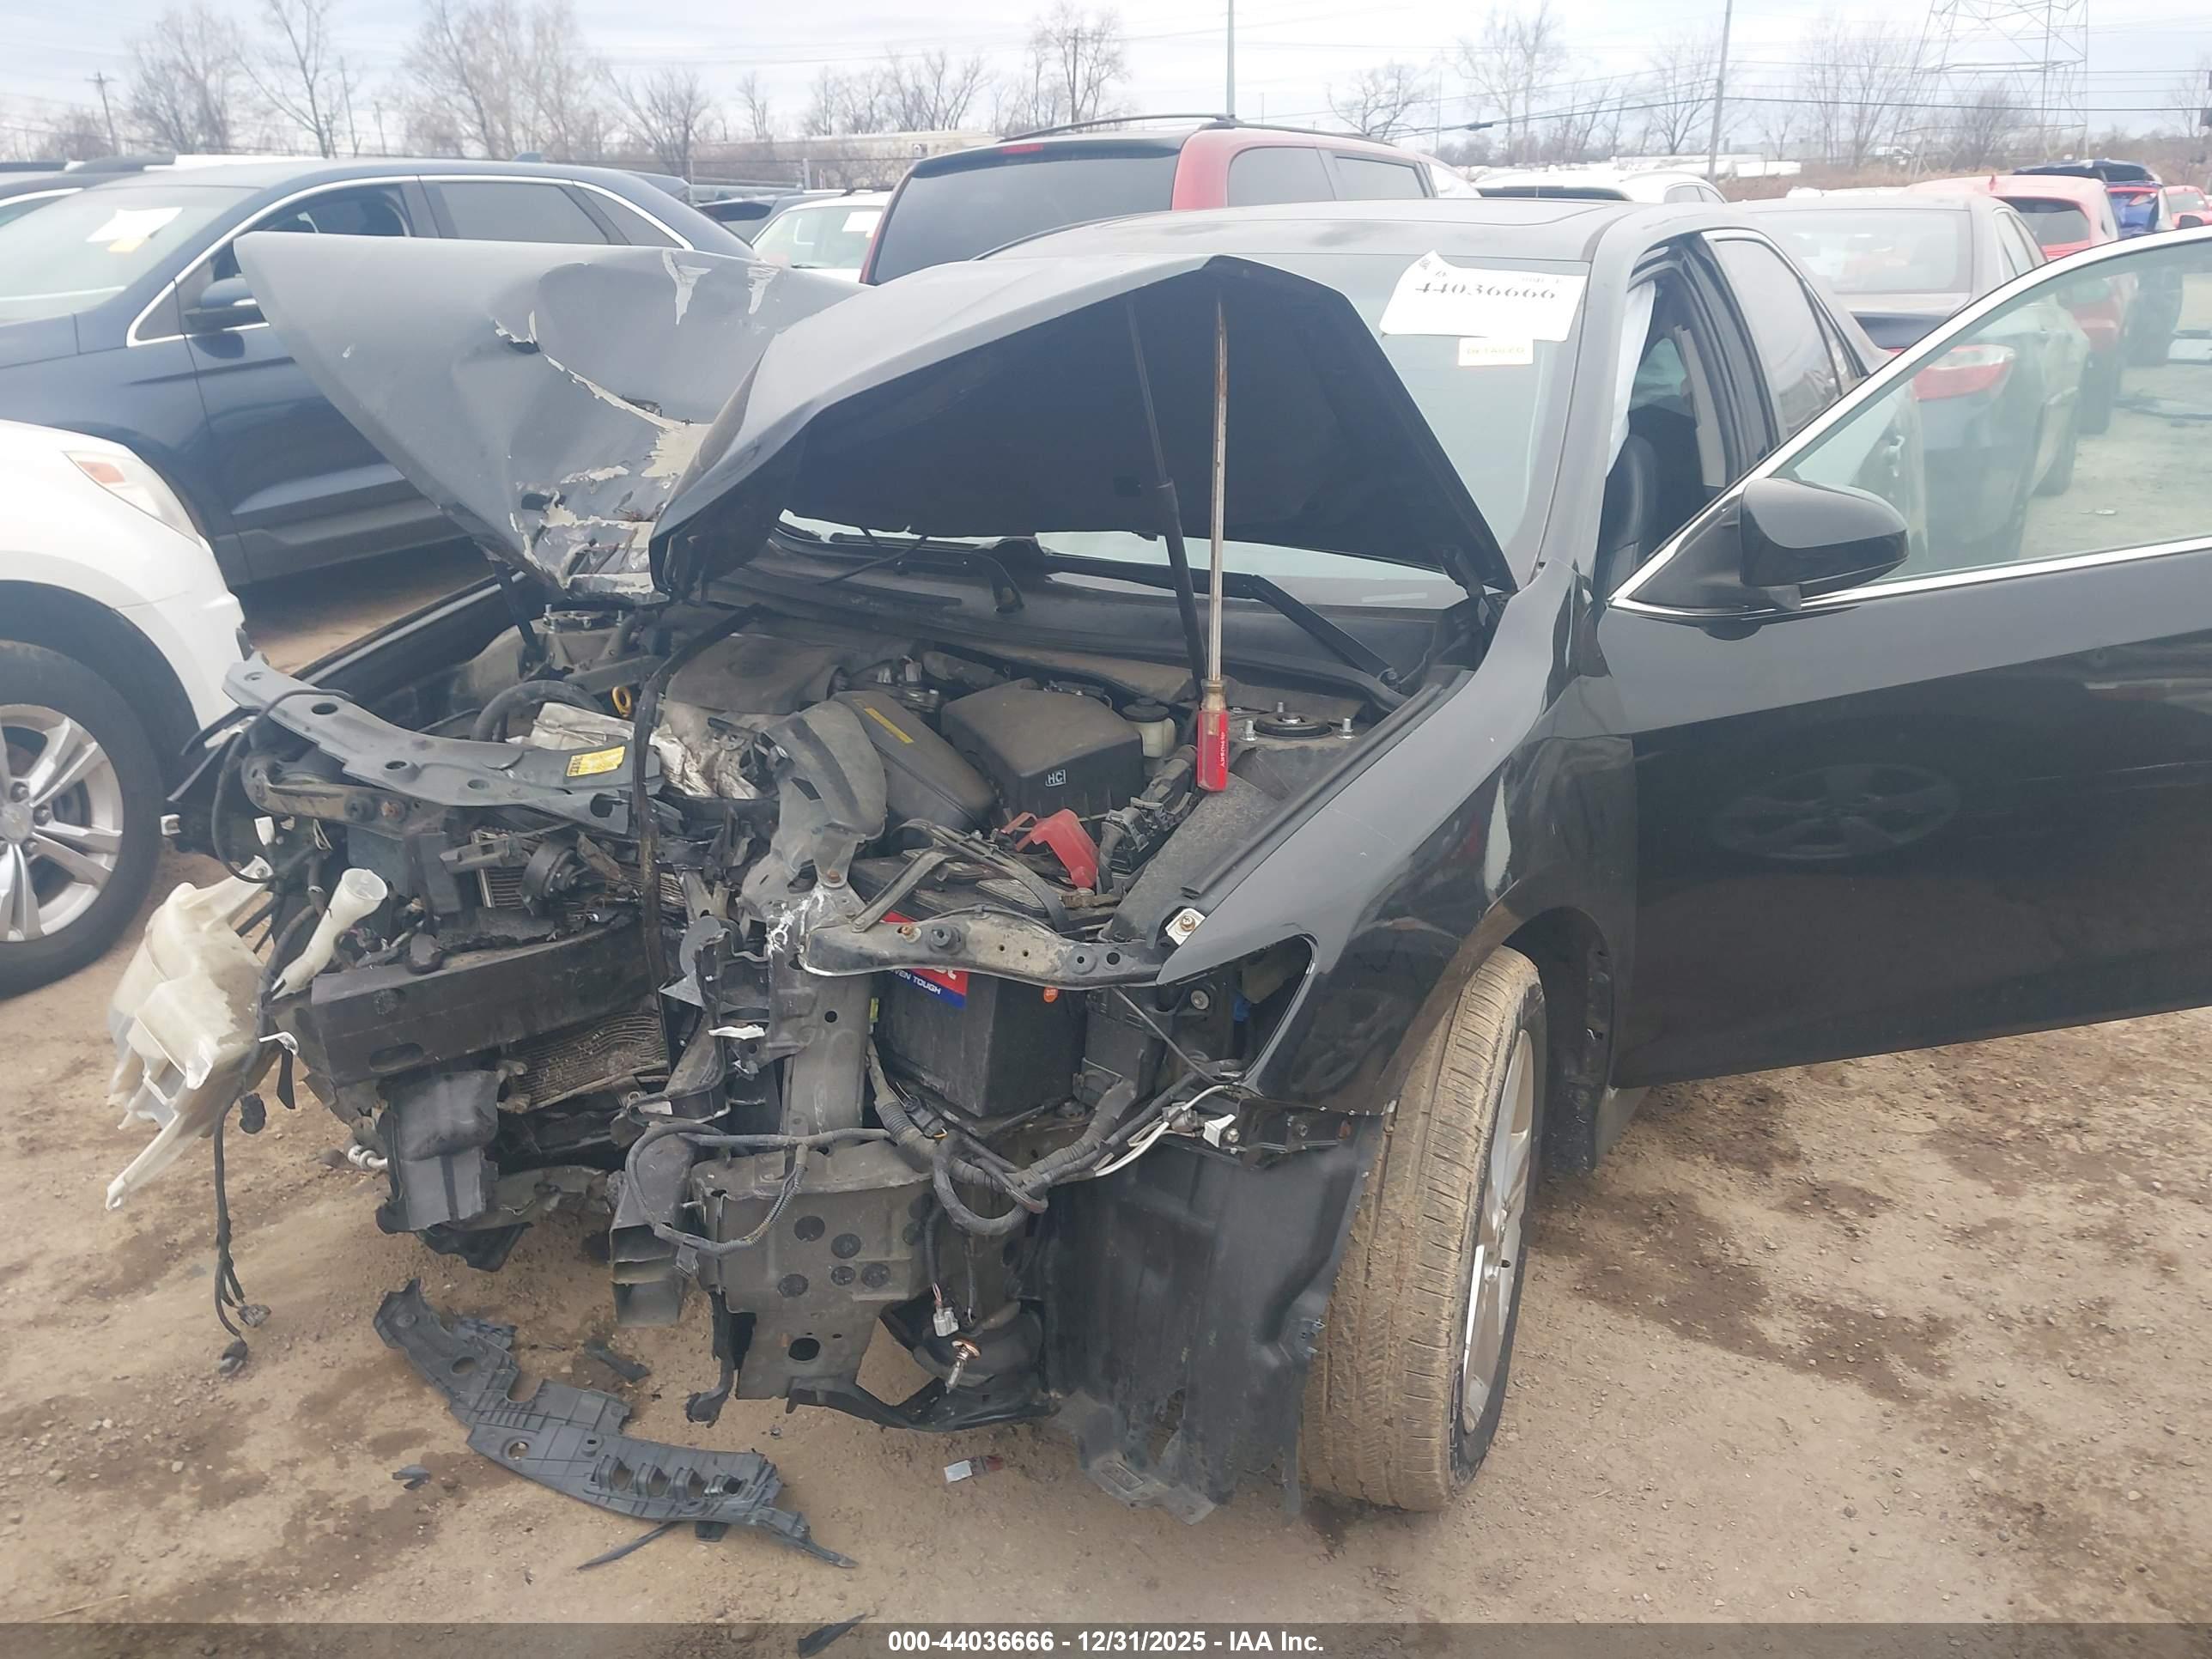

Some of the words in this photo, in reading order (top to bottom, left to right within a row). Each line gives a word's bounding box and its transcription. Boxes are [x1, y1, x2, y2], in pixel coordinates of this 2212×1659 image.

[1414, 283, 1556, 300] 44036666
[1048, 772, 1063, 784] HC
[913, 975, 942, 995] TOUGH
